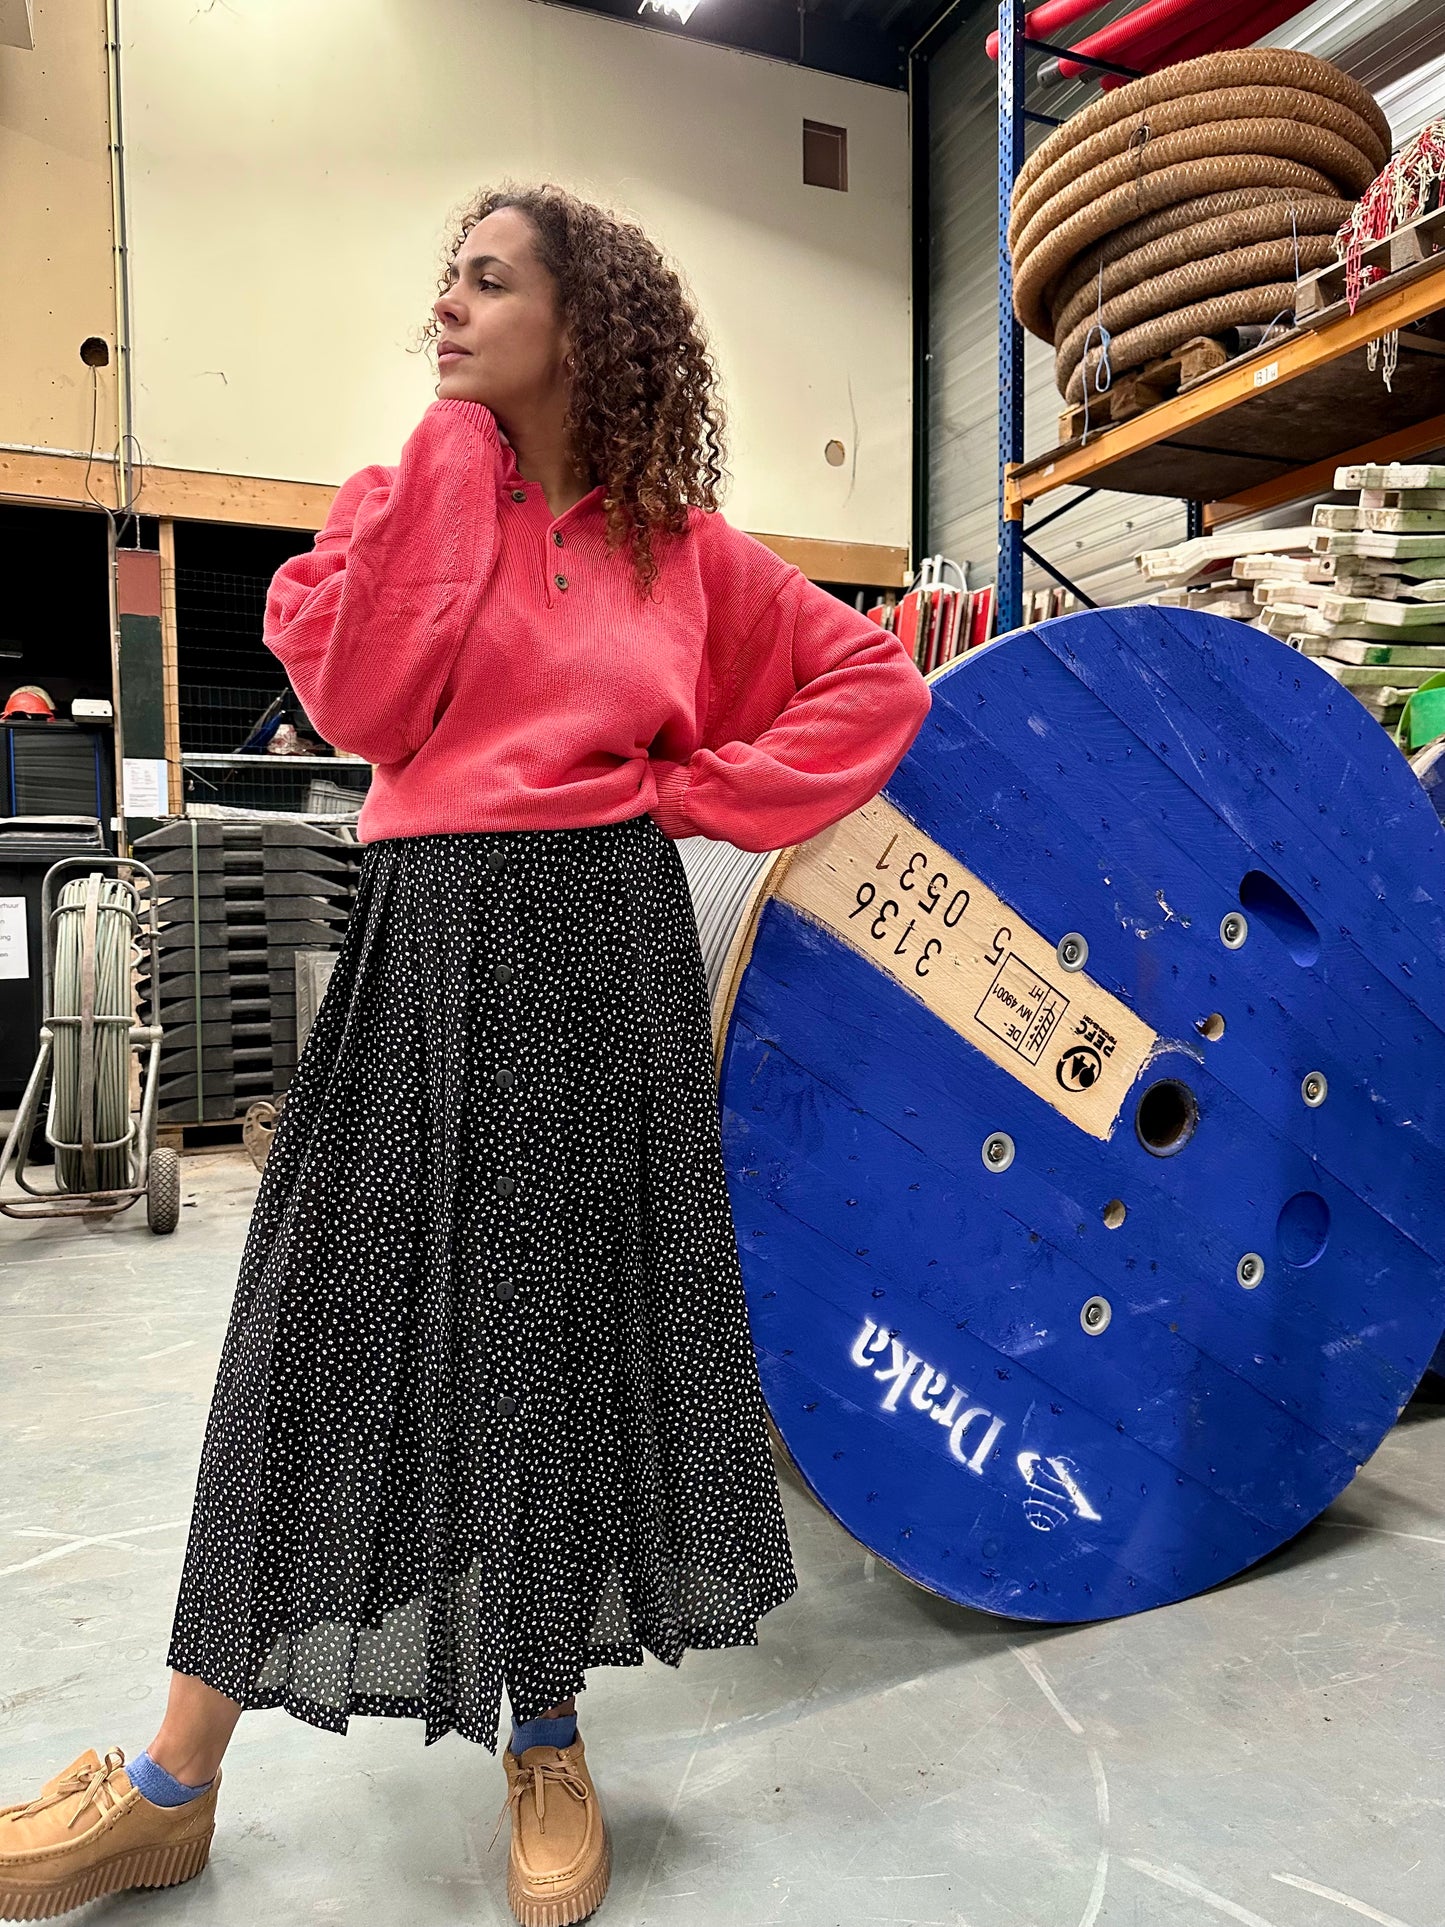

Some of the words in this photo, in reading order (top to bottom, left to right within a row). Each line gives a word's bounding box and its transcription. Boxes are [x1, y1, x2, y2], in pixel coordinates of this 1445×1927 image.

[876, 833, 970, 928] 0531
[848, 882, 942, 977] 3136
[992, 983, 1018, 1009] 49001
[1028, 985, 1044, 1002] HT
[1016, 1004, 1033, 1022] MV
[1074, 1020, 1116, 1058] PEFC
[850, 1317, 1006, 1475] Draka
